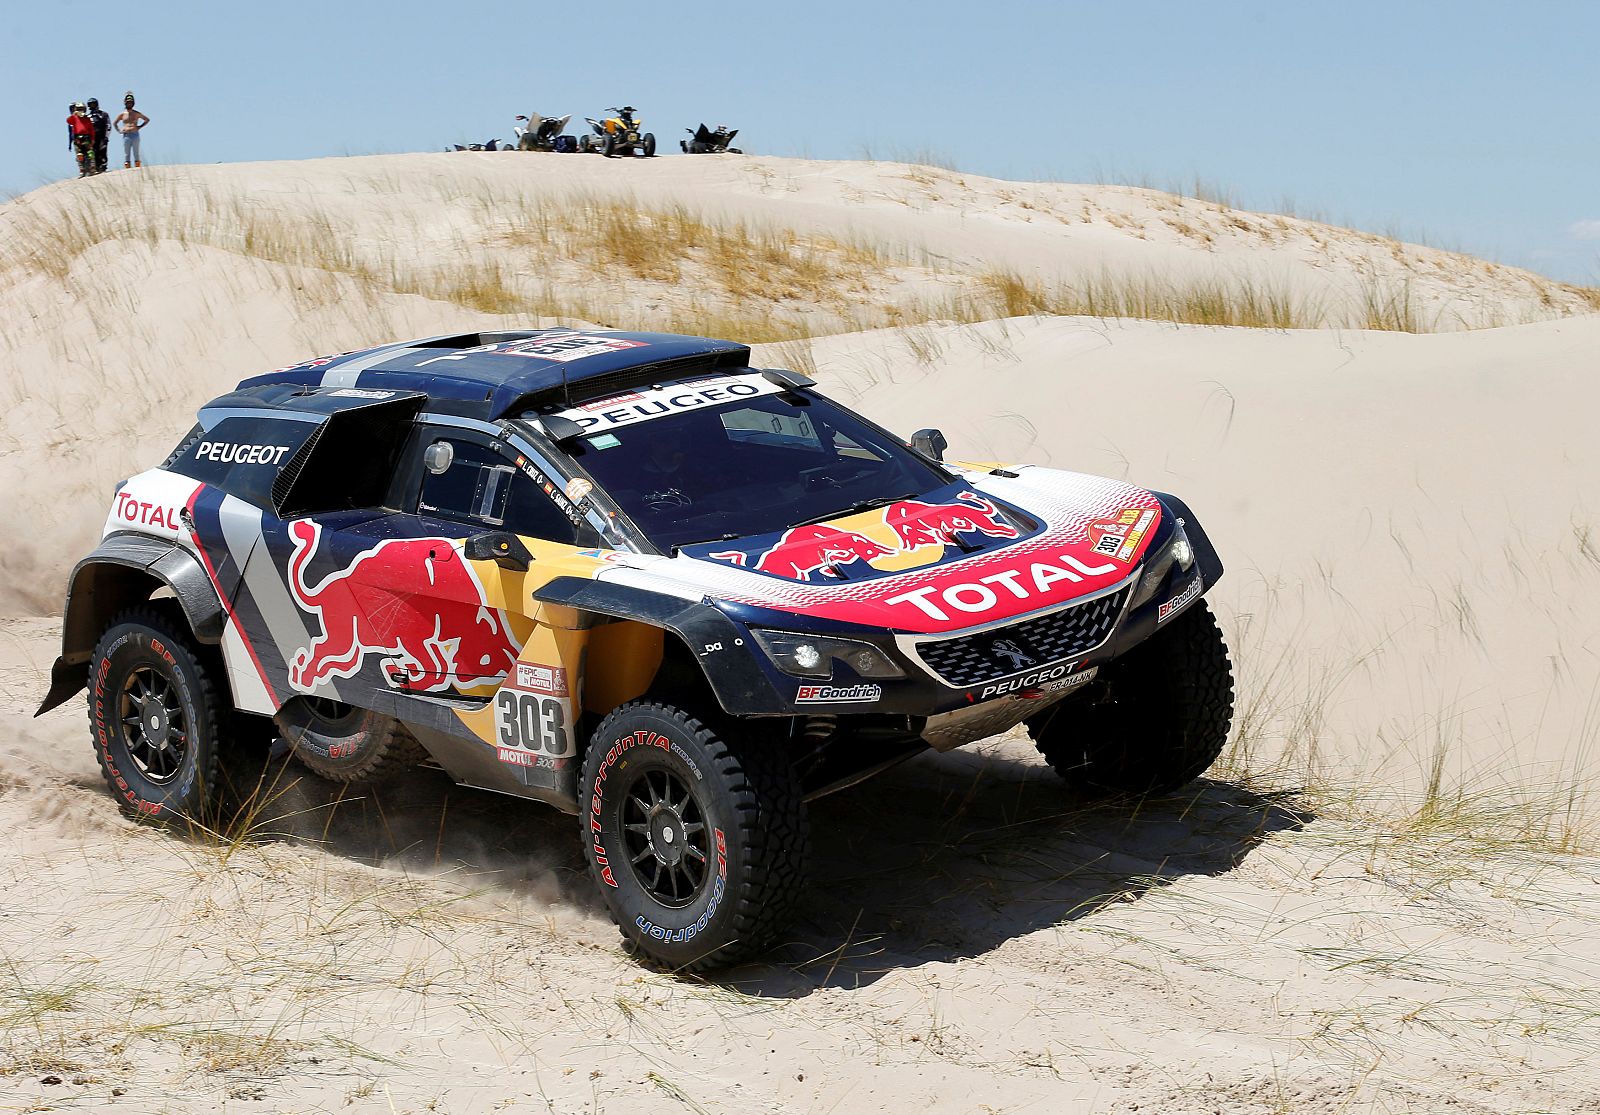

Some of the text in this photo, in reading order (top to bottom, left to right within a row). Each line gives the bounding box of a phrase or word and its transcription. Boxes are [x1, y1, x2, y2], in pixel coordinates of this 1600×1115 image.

[195, 441, 290, 465] PEUGEOT
[117, 492, 179, 531] TOTAL
[1097, 536, 1121, 553] 303
[884, 554, 1118, 621] TOTAL
[1159, 576, 1201, 618] BFGoodrich
[530, 678, 551, 689] MOTUL
[799, 684, 882, 699] BFGoodrich
[980, 660, 1079, 699] PEUGEOT
[498, 690, 568, 755] 303
[499, 749, 533, 766] MOTUL
[635, 826, 728, 944] BFGoodrich
